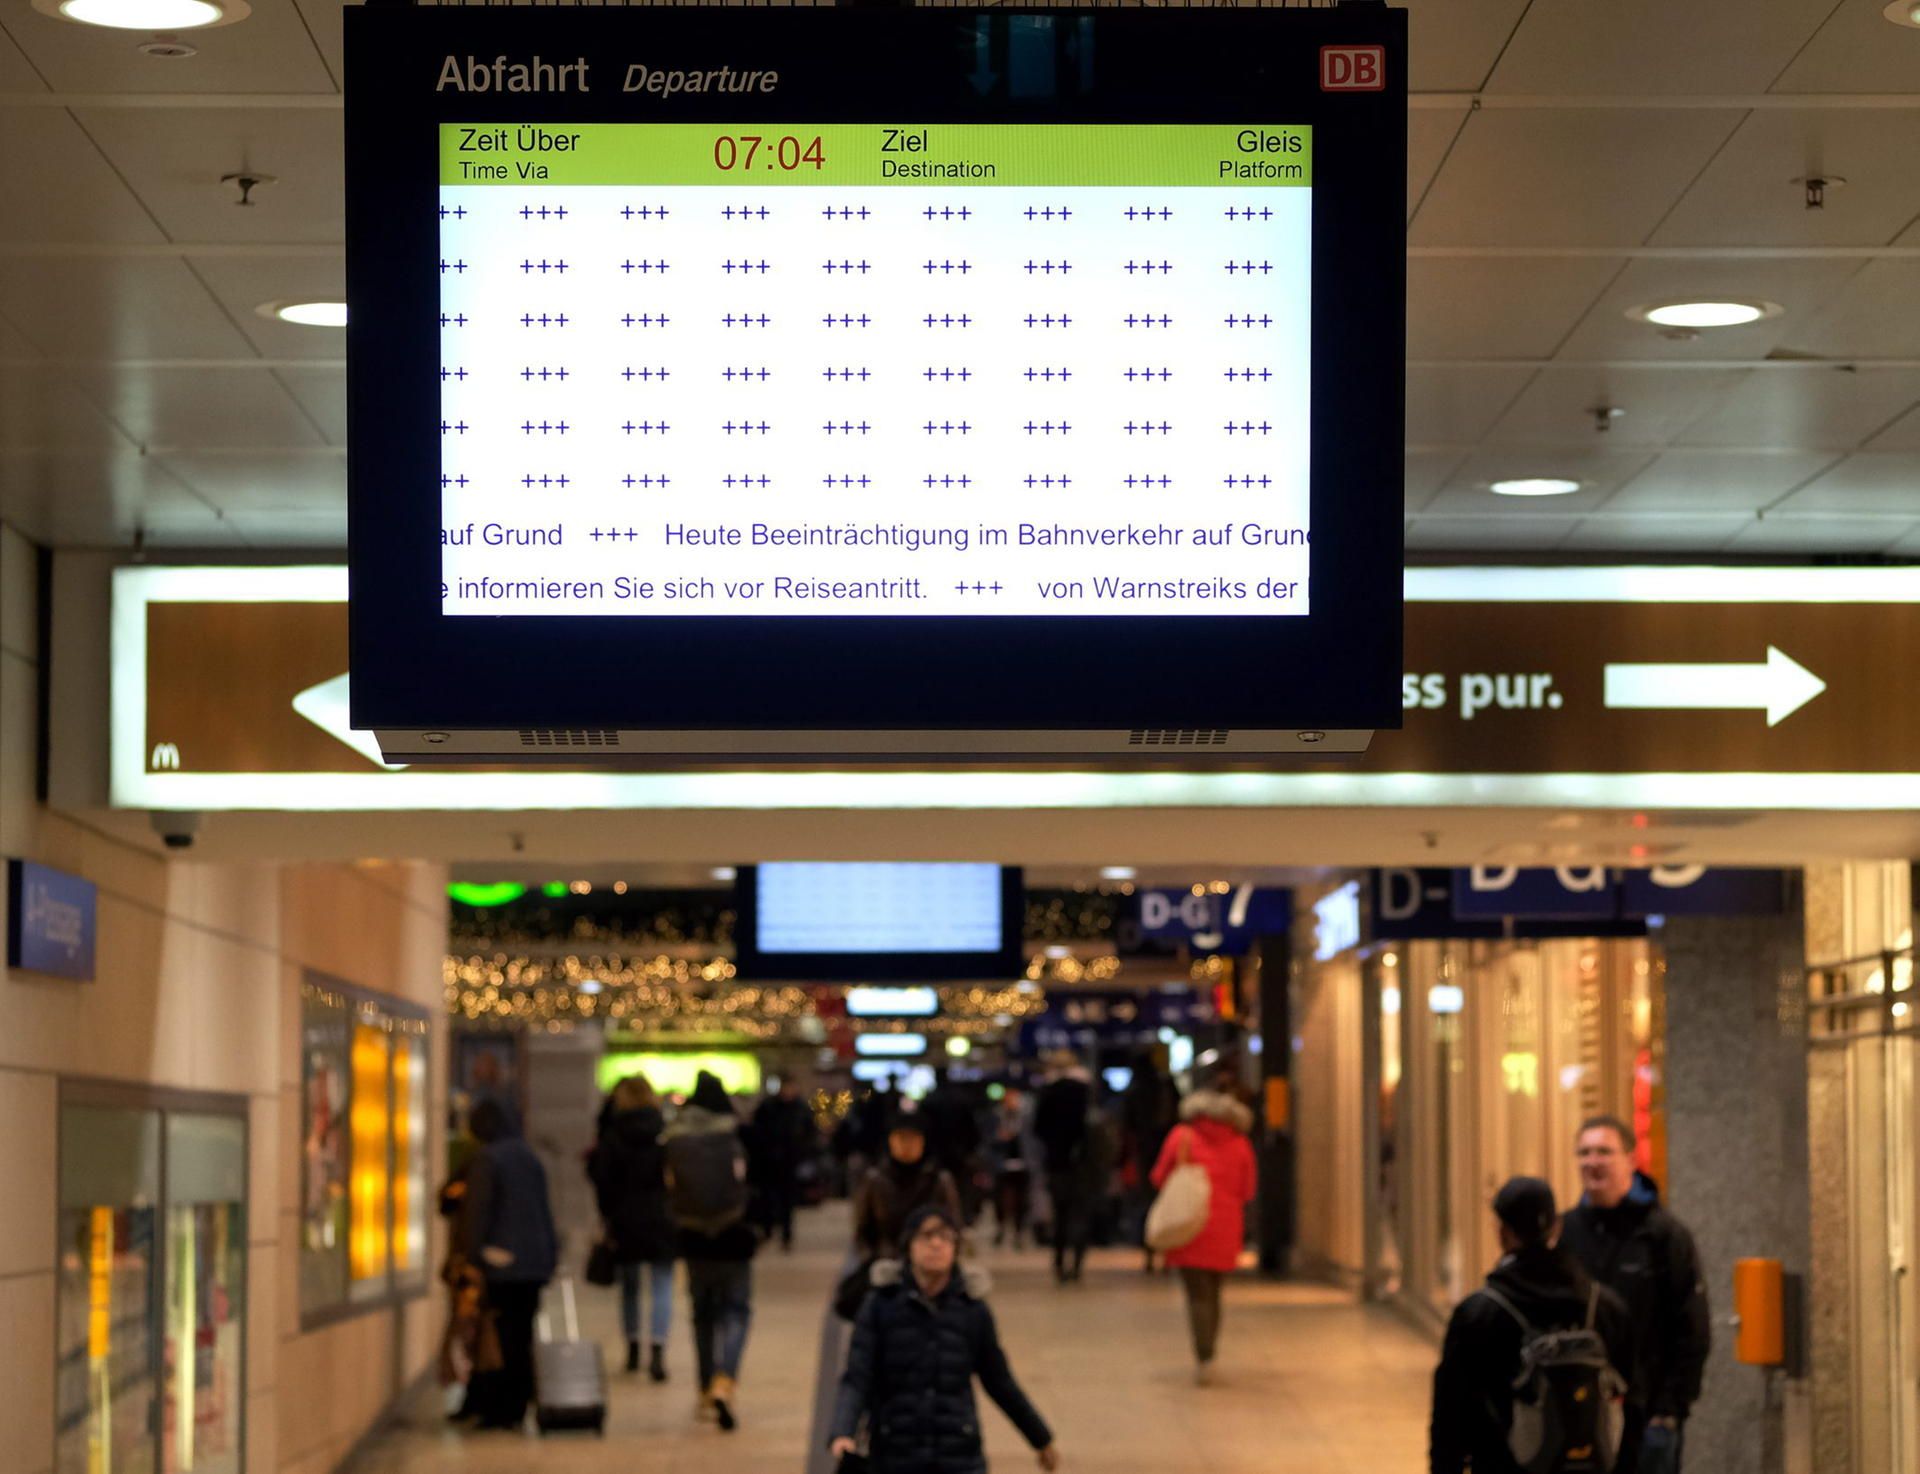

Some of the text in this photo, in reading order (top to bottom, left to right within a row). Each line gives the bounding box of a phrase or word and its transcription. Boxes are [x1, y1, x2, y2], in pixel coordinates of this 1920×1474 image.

[436, 55, 779, 99] Abfahrt Departure
[1328, 52, 1377, 84] DB
[458, 125, 581, 152] Zeit Über
[881, 129, 928, 153] Ziel
[1236, 130, 1303, 154] Gleis
[713, 135, 826, 171] 07:04
[458, 161, 549, 179] Time Via
[882, 160, 996, 179] Destination
[1219, 160, 1303, 179] Platform
[482, 523, 562, 546] Grund
[666, 523, 741, 546] Heute
[752, 523, 969, 551] Beeinträchtigung
[979, 523, 1008, 546] im
[1019, 523, 1184, 546] Bahnverkehr
[1192, 523, 1233, 546] auf
[458, 576, 604, 599] informieren
[614, 576, 654, 599] Sie
[664, 576, 714, 599] sich
[724, 582, 765, 599] vor
[775, 576, 928, 599] Reiseantritt.
[1037, 582, 1083, 599] von
[1093, 576, 1247, 599] Warnstreiks
[1256, 577, 1298, 599] der
[1459, 673, 1564, 720] pur.
